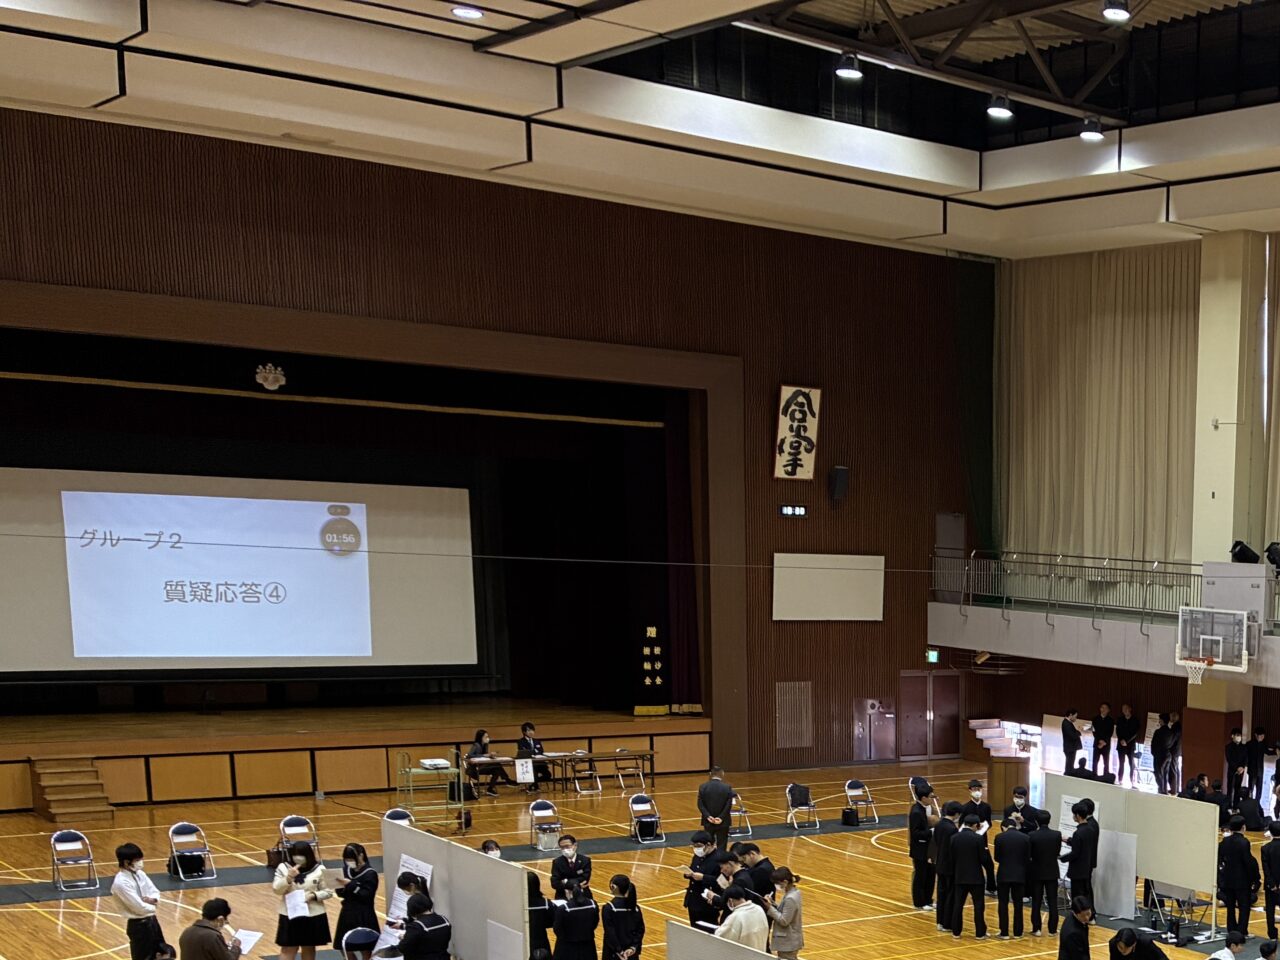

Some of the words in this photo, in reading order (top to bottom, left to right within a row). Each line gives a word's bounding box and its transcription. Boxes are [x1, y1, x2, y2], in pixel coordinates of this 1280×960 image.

[325, 533, 356, 543] 01:56
[163, 580, 287, 604] 質疑応答④
